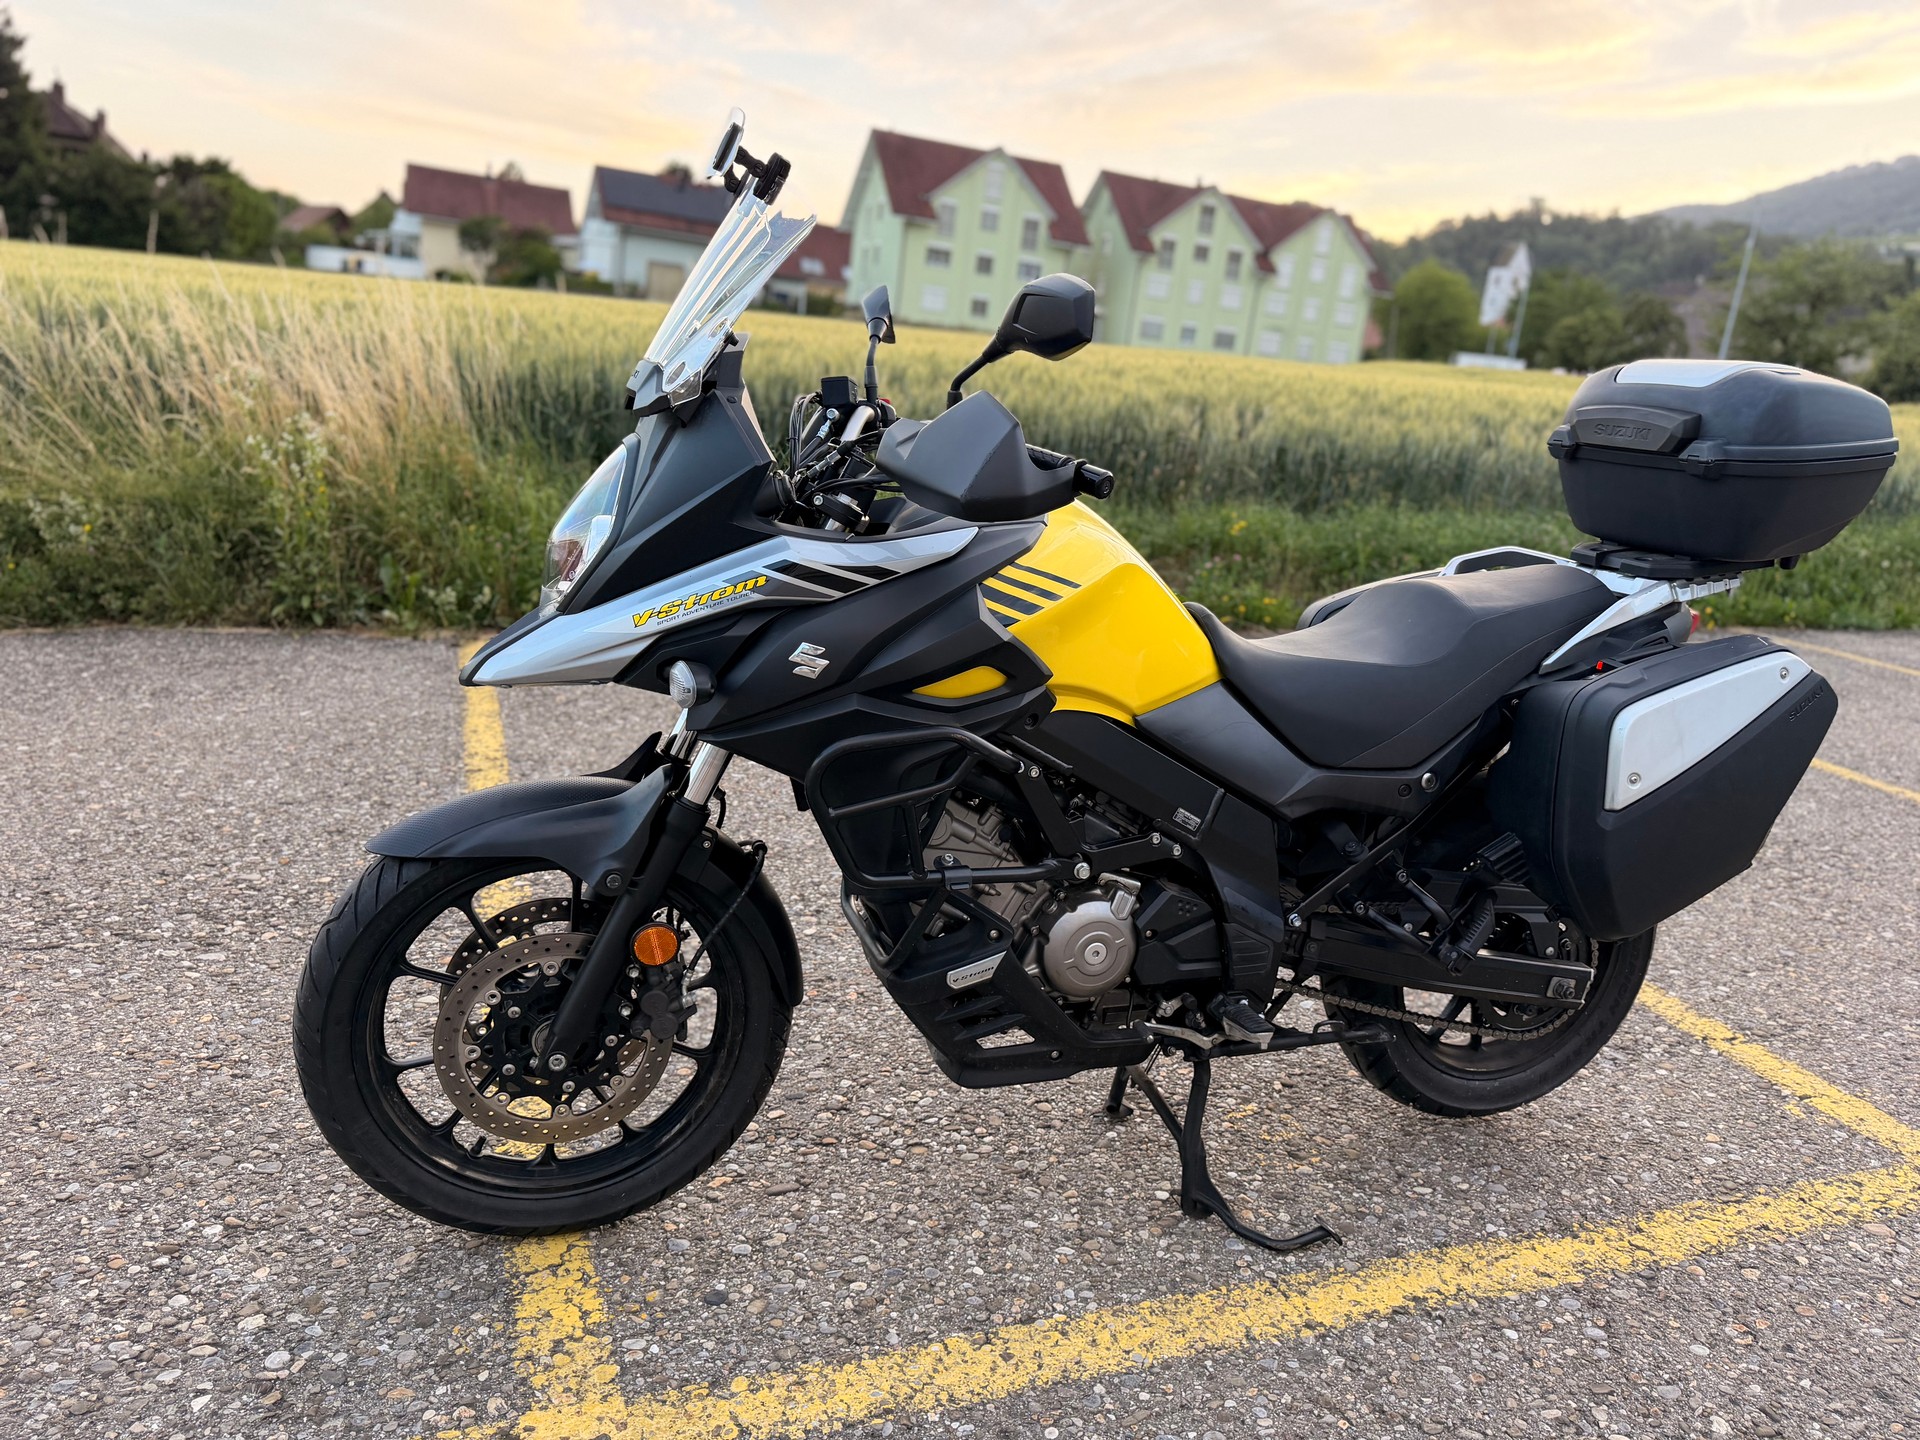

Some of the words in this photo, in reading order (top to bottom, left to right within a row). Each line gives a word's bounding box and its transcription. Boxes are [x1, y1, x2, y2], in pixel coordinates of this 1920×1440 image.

[1594, 423, 1651, 441] SUZUKI
[632, 575, 769, 628] V-Strom
[657, 614, 681, 626] SPORT
[681, 601, 725, 618] ADVENTURE
[1789, 685, 1823, 721] SUZUKI
